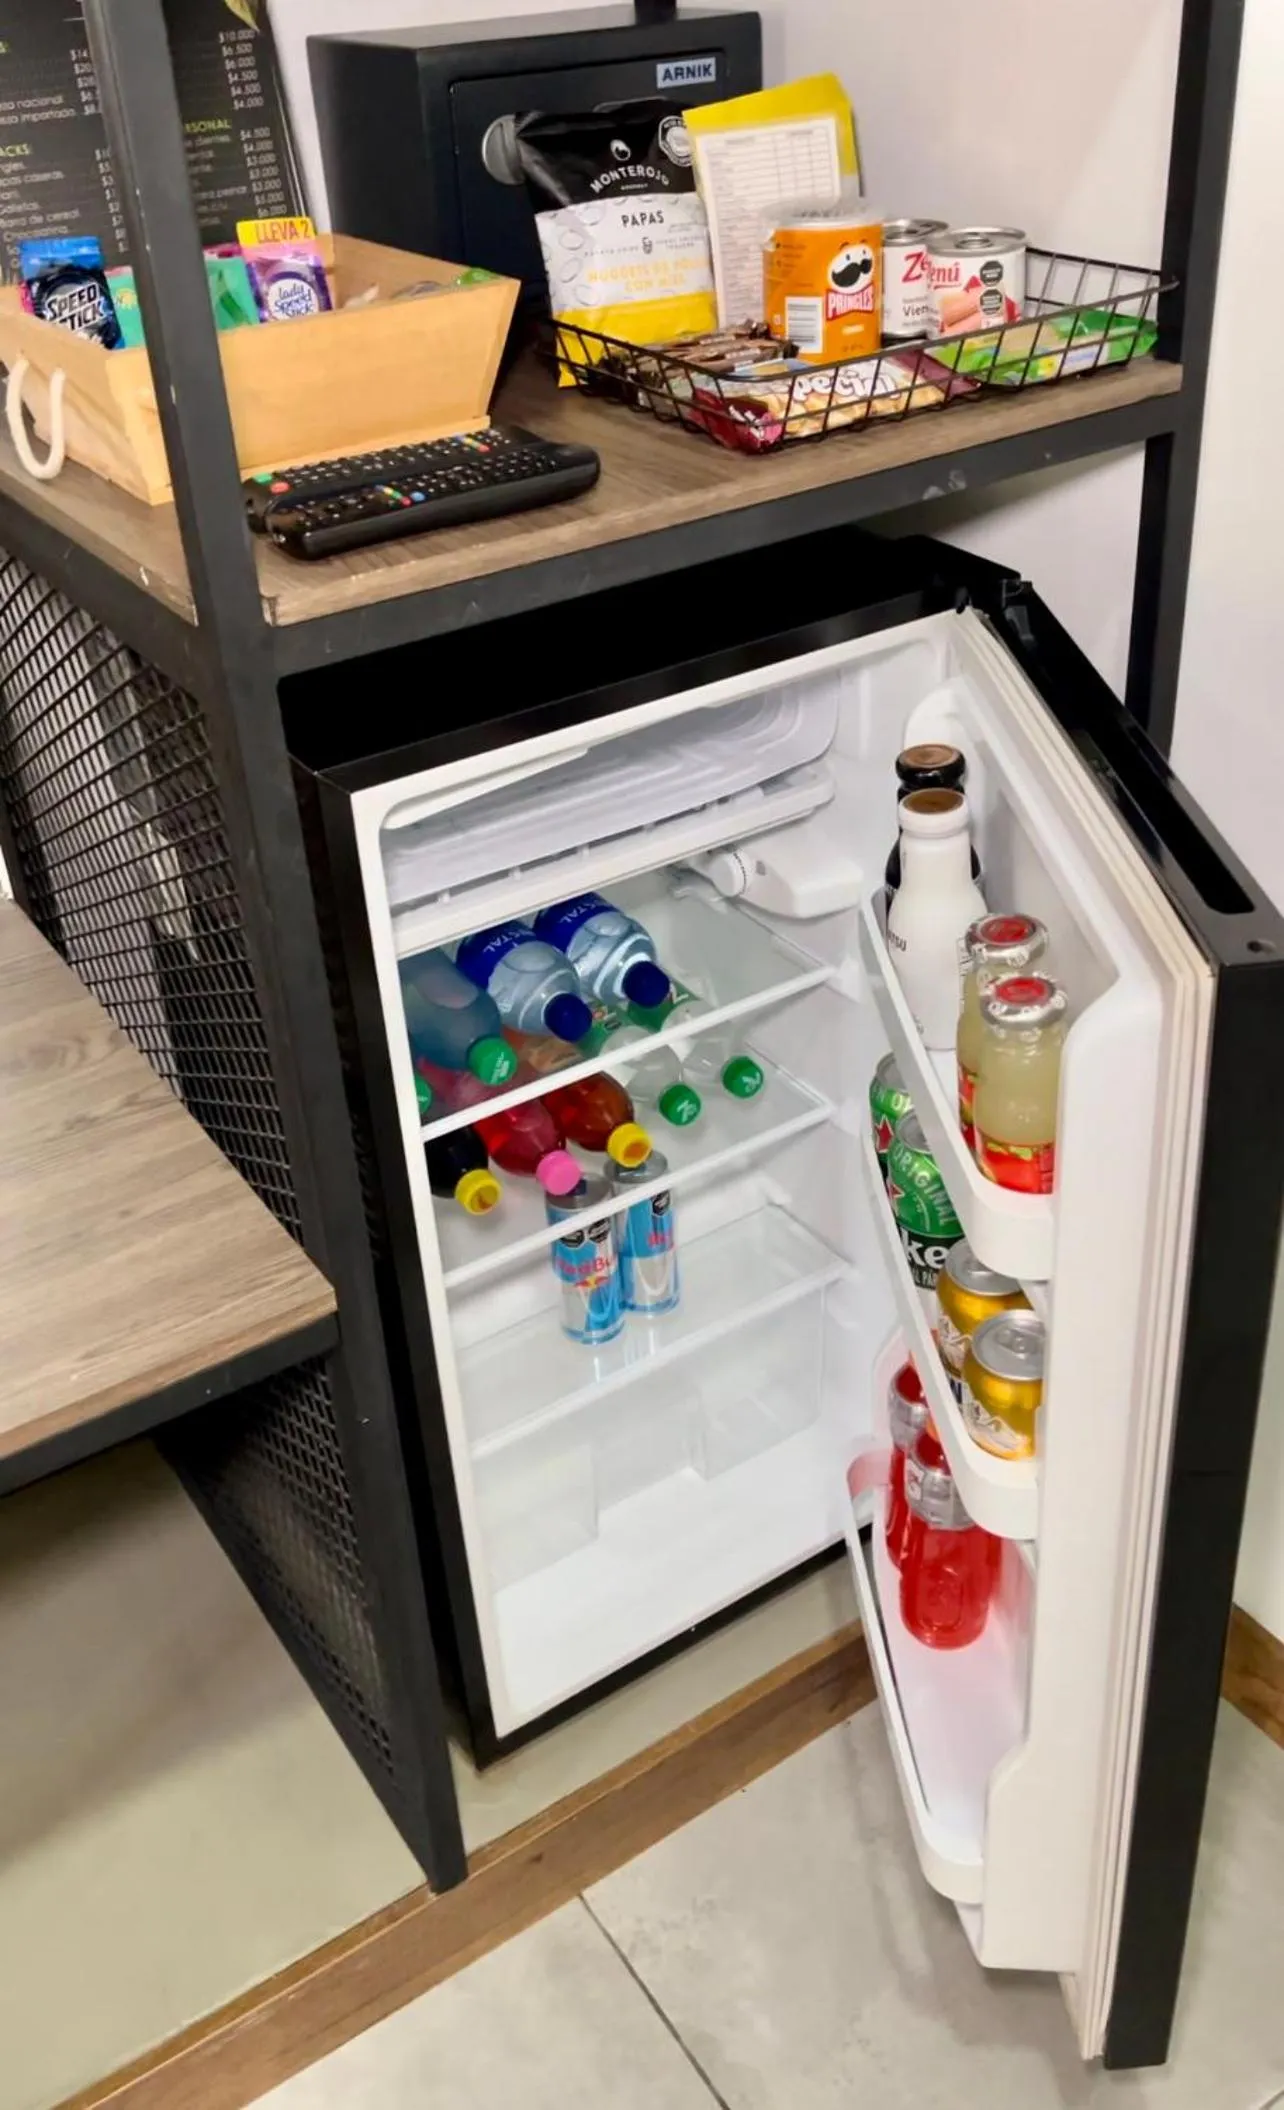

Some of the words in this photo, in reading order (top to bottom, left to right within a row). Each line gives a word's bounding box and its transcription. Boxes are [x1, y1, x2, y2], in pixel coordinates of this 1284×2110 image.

[663, 63, 713, 82] ARNIK
[621, 209, 665, 228] PAPAS
[256, 219, 299, 244] LLEVA
[300, 219, 310, 237] 2
[46, 283, 98, 321] SPEED
[828, 284, 873, 319] PRINGLES
